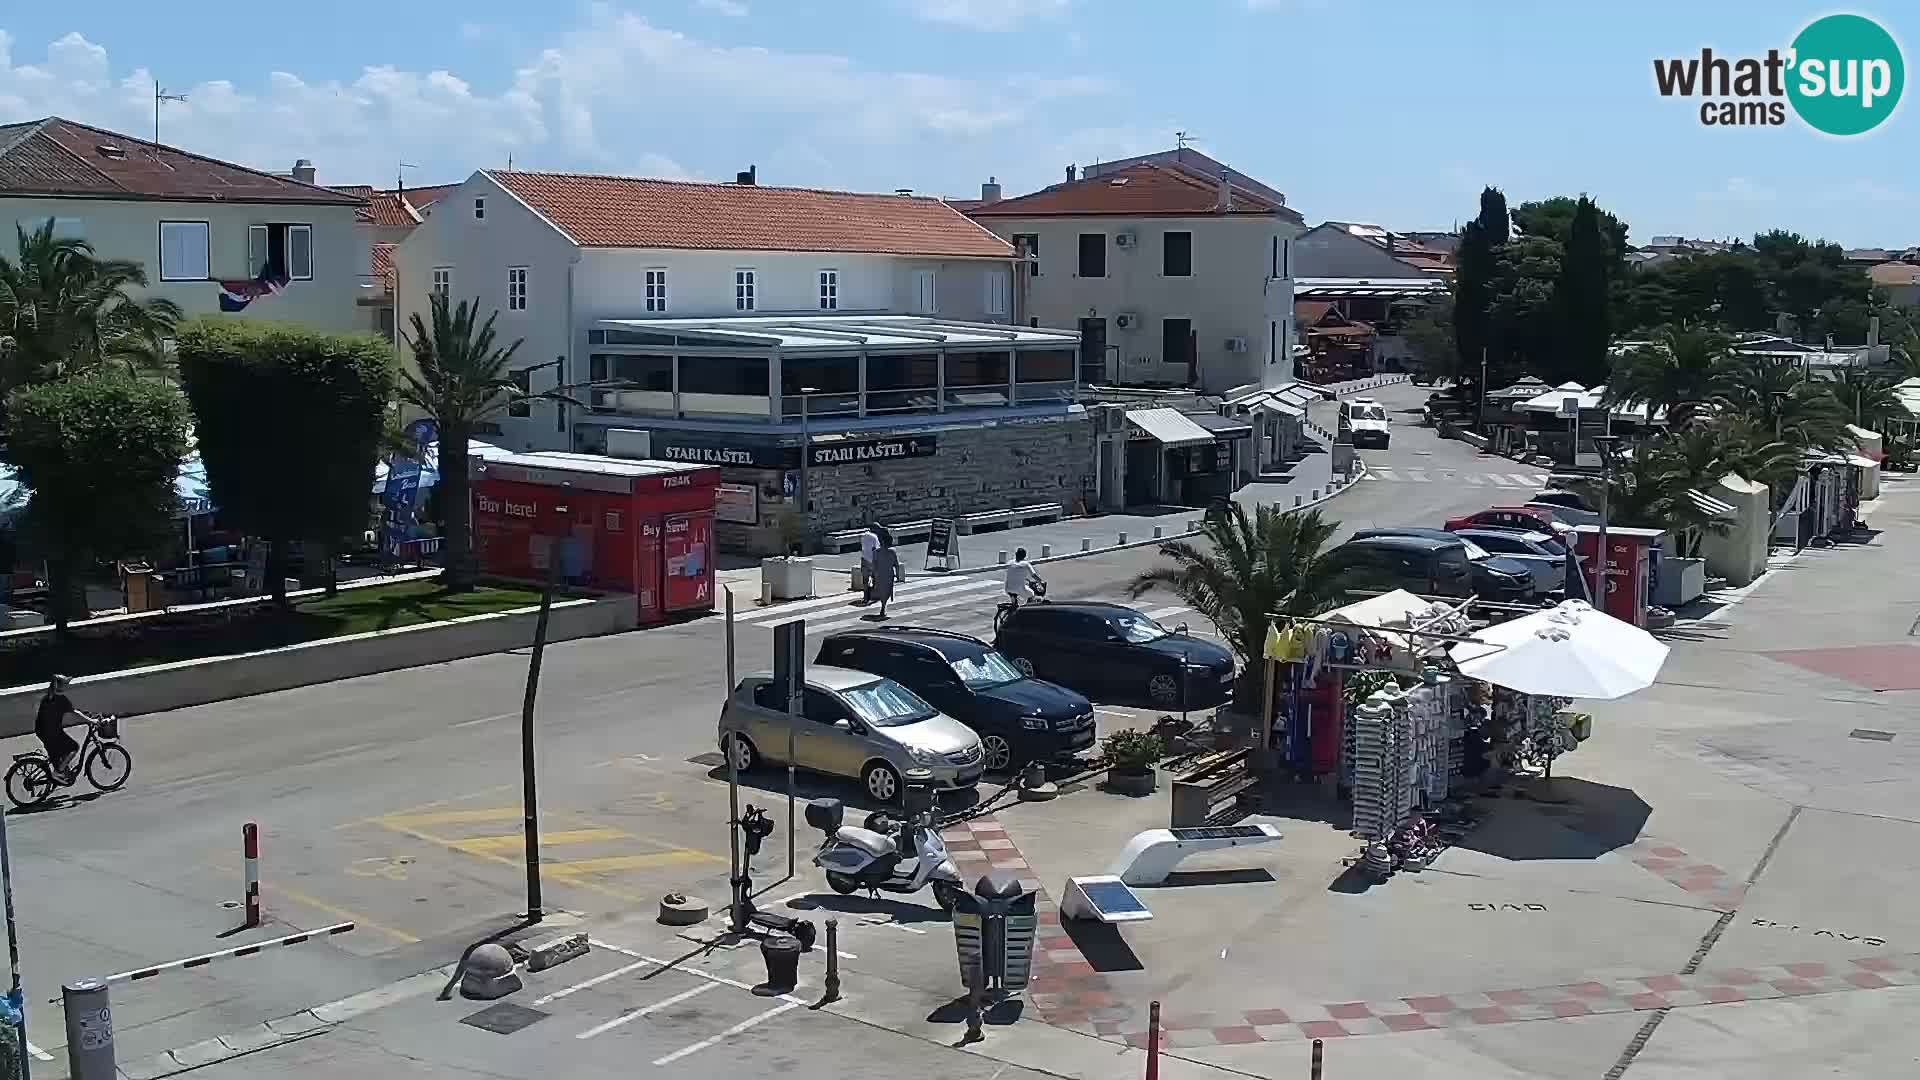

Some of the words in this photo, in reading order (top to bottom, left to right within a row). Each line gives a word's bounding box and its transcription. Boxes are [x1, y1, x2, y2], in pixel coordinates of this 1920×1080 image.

[665, 446, 701, 461] STARI
[703, 447, 754, 464] KAŠTEL
[815, 447, 854, 463] STARI
[856, 441, 906, 459] KAŠTEL
[663, 476, 691, 489] TISAK
[505, 498, 537, 517] here!
[643, 524, 661, 538] Buy
